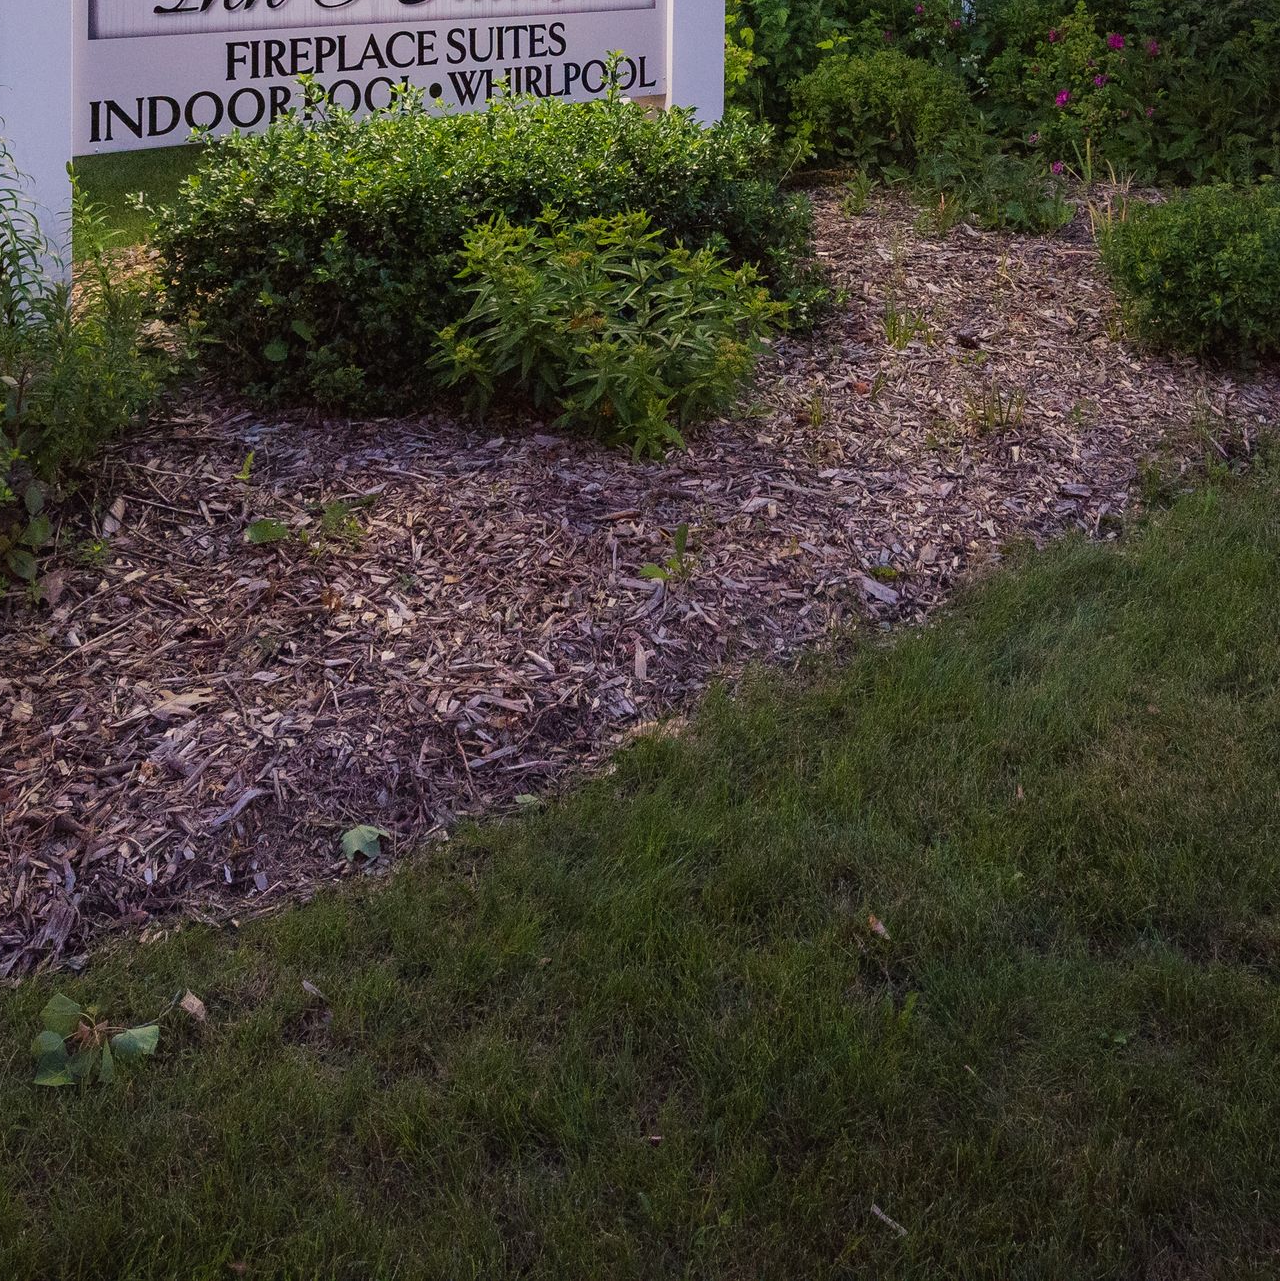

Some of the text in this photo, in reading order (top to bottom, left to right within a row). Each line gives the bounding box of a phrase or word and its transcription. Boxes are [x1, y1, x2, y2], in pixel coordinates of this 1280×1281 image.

[225, 22, 567, 81] FIREPLACE SUITES
[89, 85, 292, 143] INDOOR
[447, 56, 657, 107] WHIRLPOOL
